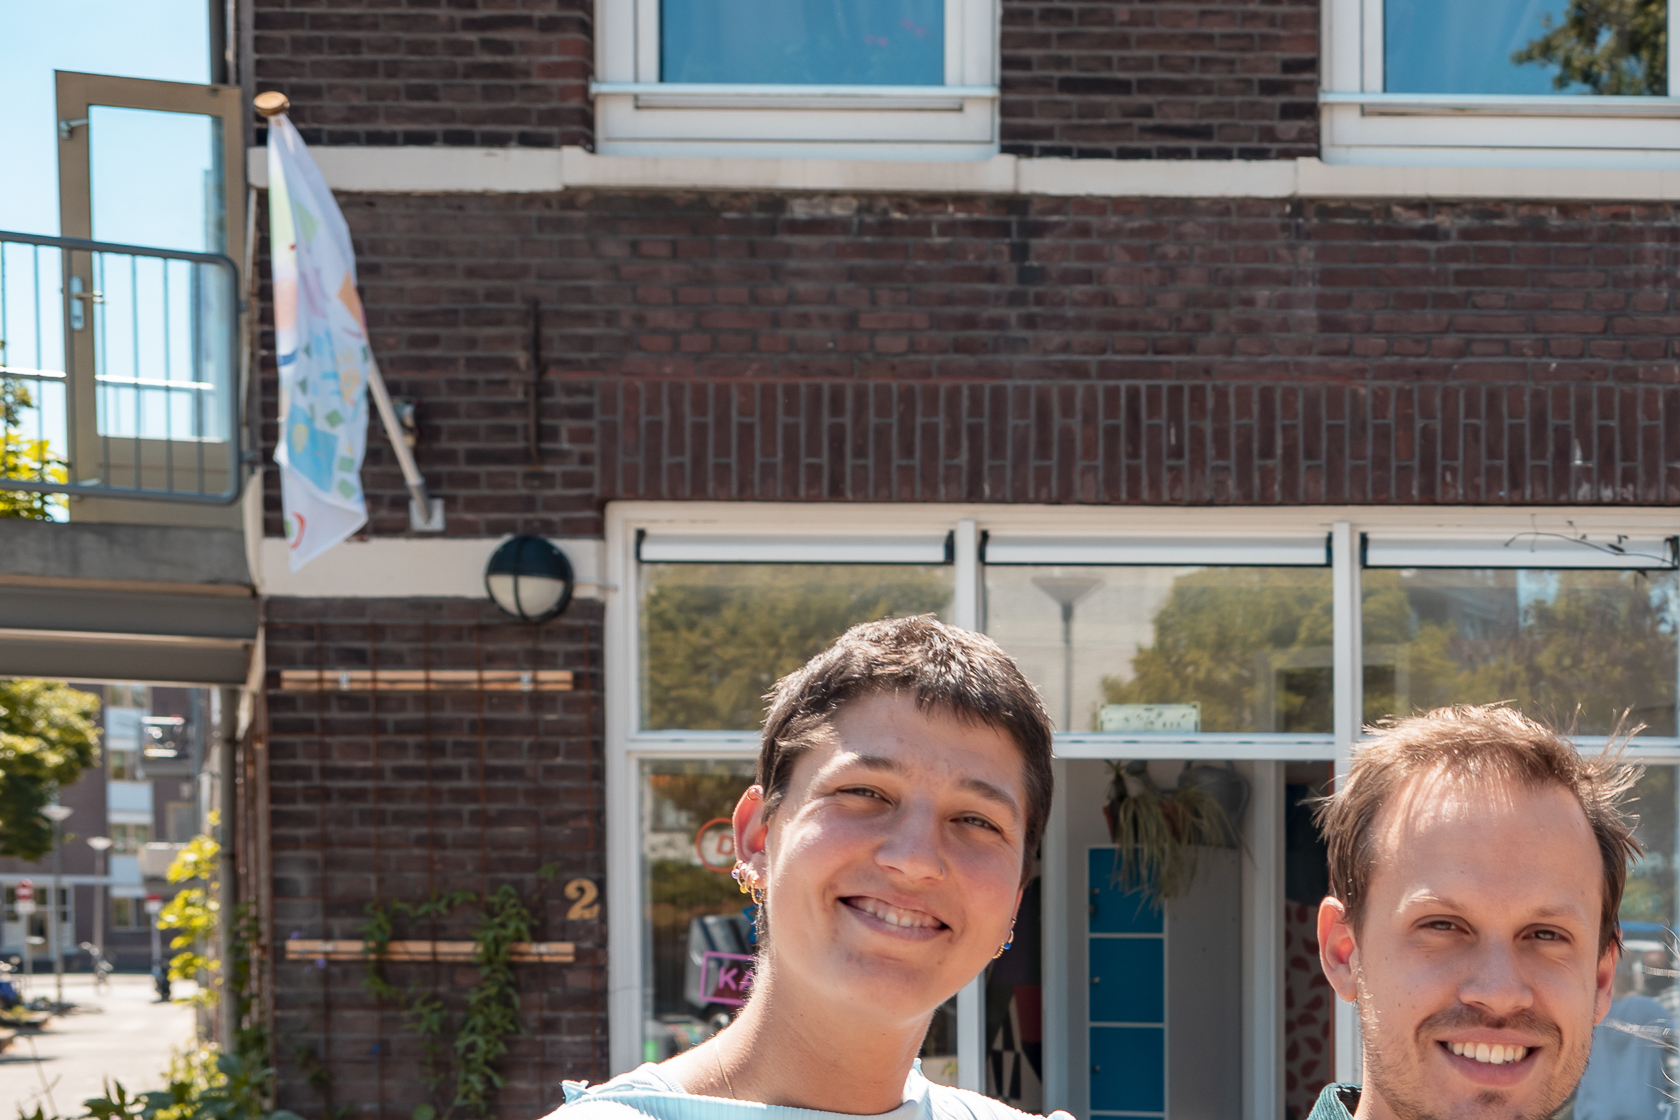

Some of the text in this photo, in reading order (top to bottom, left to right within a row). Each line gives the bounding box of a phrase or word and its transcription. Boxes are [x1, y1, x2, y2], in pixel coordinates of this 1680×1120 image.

[716, 833, 735, 856] D
[564, 878, 600, 920] 2
[718, 967, 755, 991] KA
